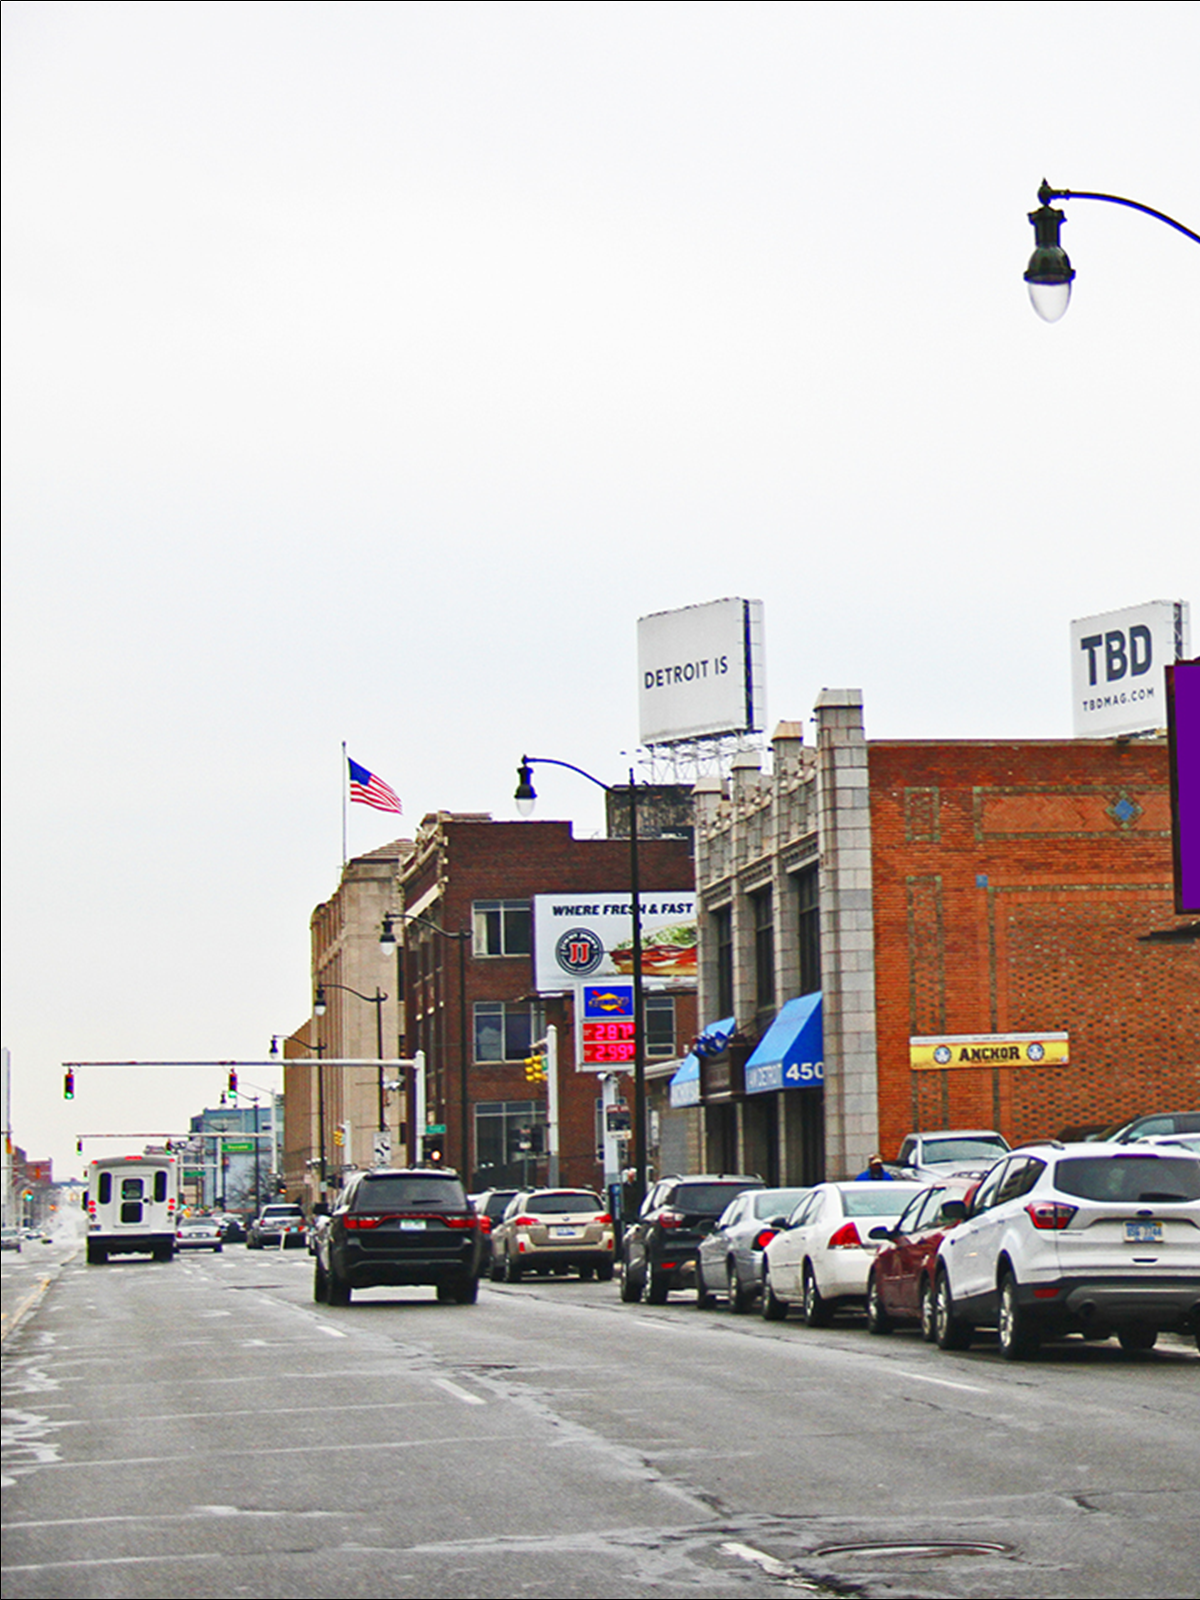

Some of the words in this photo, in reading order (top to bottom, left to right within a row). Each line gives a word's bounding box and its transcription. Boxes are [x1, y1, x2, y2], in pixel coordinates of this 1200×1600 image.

[1080, 624, 1152, 686] TBD
[644, 660, 709, 690] DETROIT
[714, 655, 729, 675] IS
[1082, 687, 1155, 712] TBDMAG.COM
[552, 905, 600, 916] WHERE
[603, 903, 647, 915] FRESH
[648, 903, 658, 914] &
[661, 902, 694, 914] FAST
[569, 943, 589, 963] JJ
[958, 1046, 1021, 1062] ANCHOR
[785, 1061, 824, 1081] 450
